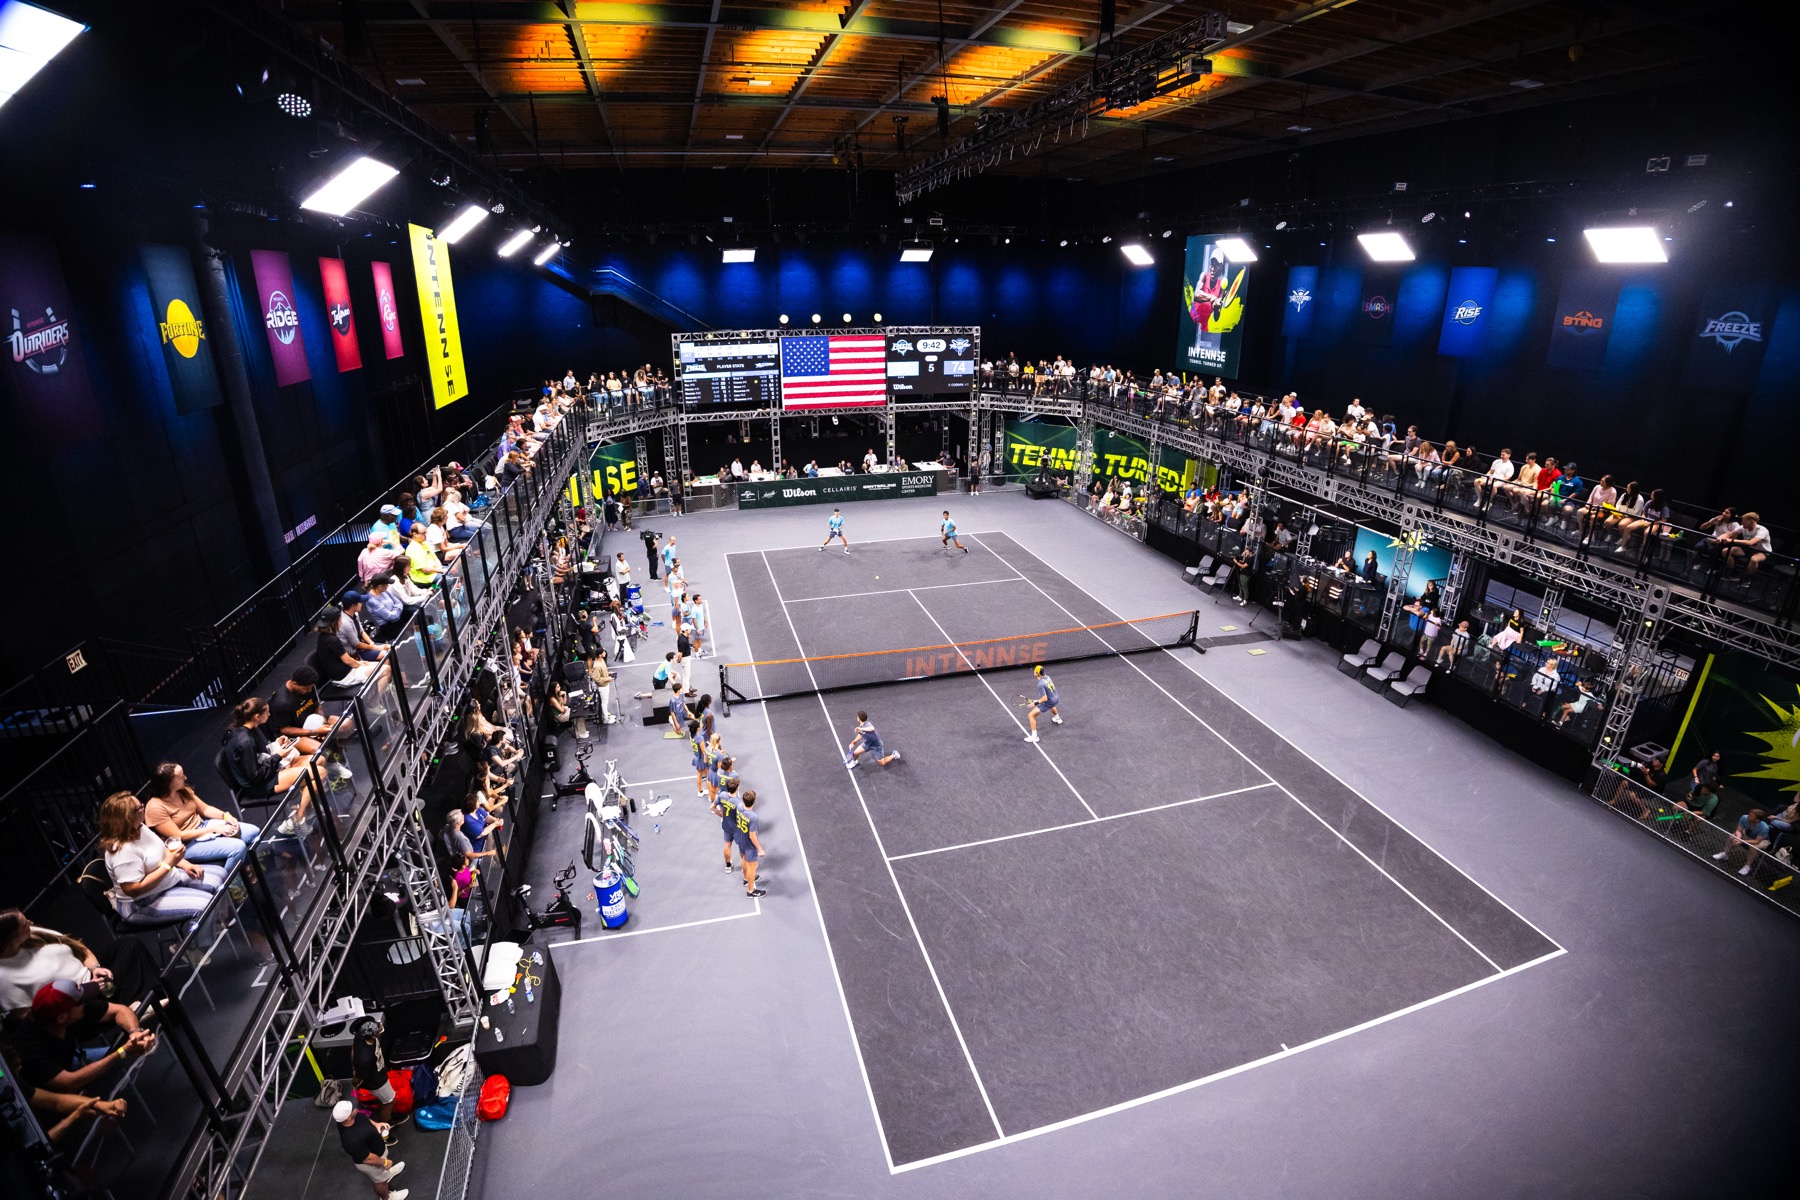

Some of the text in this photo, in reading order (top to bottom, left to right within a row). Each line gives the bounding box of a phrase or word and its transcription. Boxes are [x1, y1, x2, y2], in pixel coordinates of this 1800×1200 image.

[1364, 302, 1391, 312] SMASH
[1454, 307, 1482, 320] RISE
[266, 310, 299, 328] RIDGE
[1563, 315, 1603, 329] STING
[159, 320, 206, 345] FORTUNE
[1704, 320, 1762, 338] FREEZE
[9, 322, 70, 363] OUTRIDERS
[922, 341, 941, 349] 9:42
[1187, 346, 1227, 362] INTENNSE
[928, 363, 935, 373] 5
[951, 361, 967, 373] 74
[901, 475, 935, 486] EMORY
[782, 487, 817, 498] Wilson
[67, 652, 83, 671] EXIT
[905, 642, 1048, 678] INTENNSE
[1677, 669, 1688, 679] EXIT
[723, 804, 731, 817] 7
